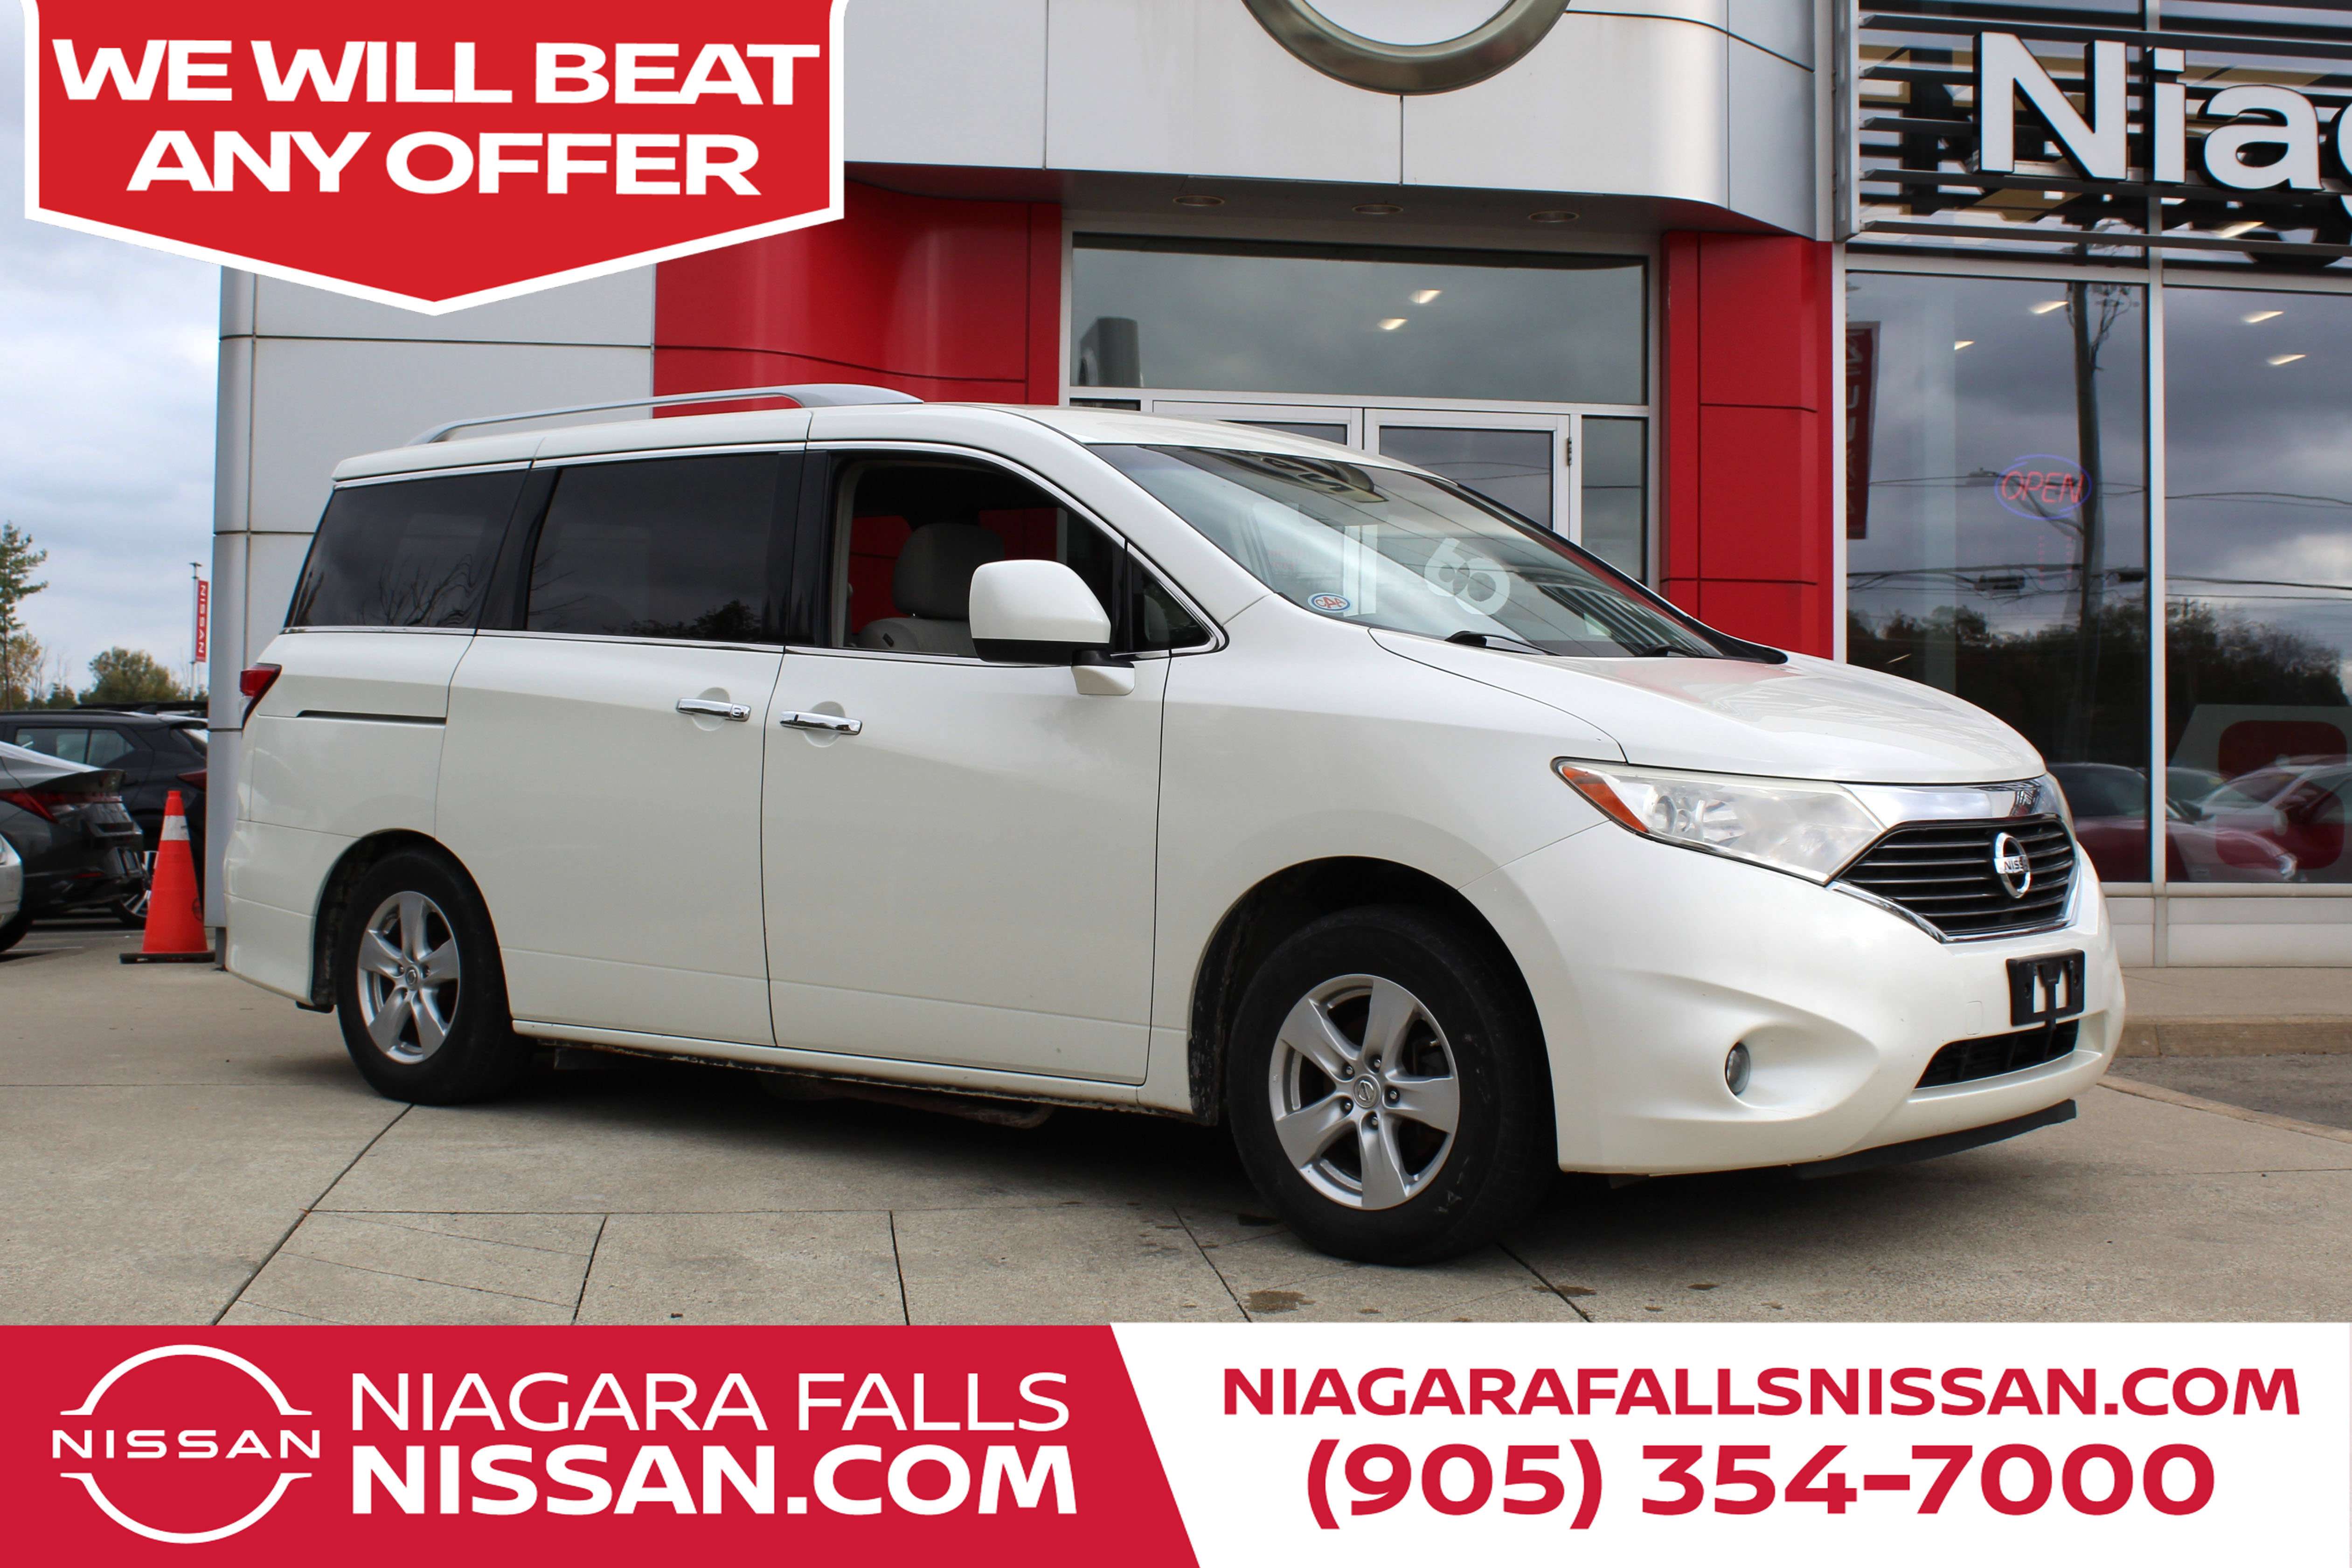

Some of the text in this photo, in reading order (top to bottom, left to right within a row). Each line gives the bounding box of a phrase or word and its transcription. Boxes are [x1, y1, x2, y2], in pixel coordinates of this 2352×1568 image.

[1980, 31, 2352, 217] Nia
[2001, 470, 2085, 504] OPEN
[1315, 596, 1346, 609] CAA
